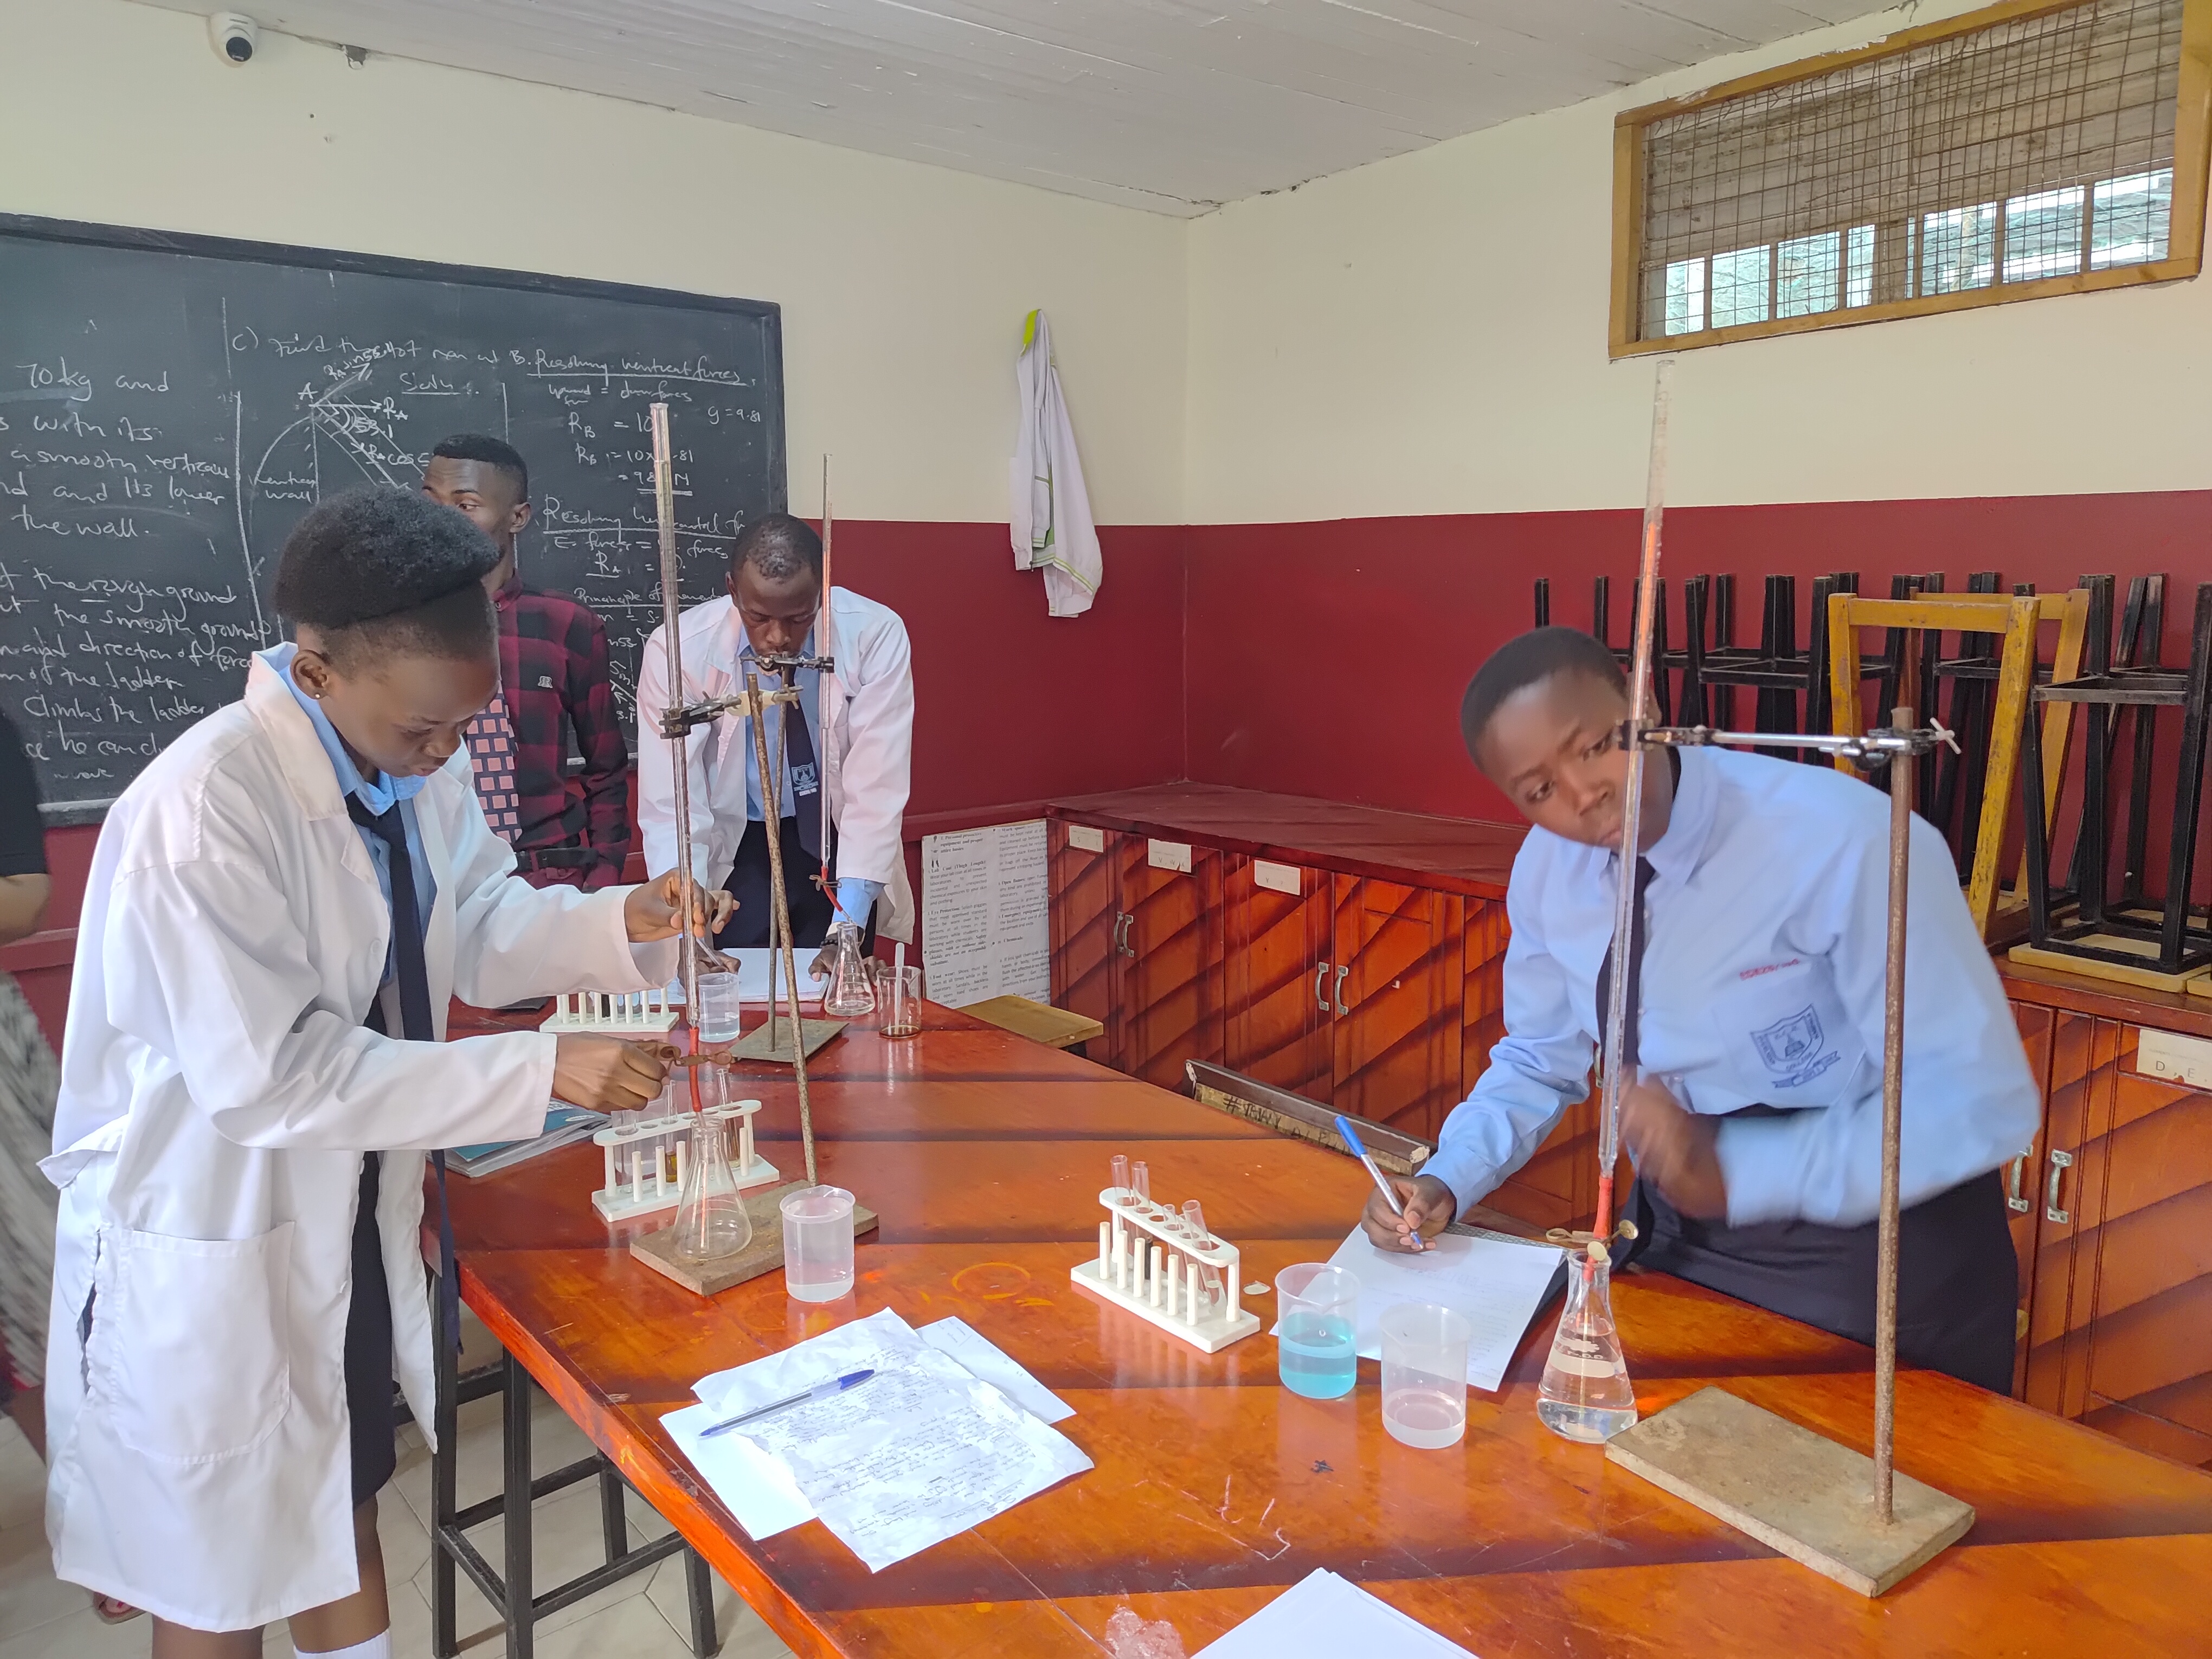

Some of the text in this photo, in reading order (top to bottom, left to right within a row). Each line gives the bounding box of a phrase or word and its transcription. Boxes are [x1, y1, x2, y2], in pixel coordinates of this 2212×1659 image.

[116, 371, 169, 391] and
[54, 483, 108, 503] and
[11, 504, 70, 535] the
[54, 603, 90, 627] the
[110, 696, 143, 723] the
[57, 719, 87, 755] he
